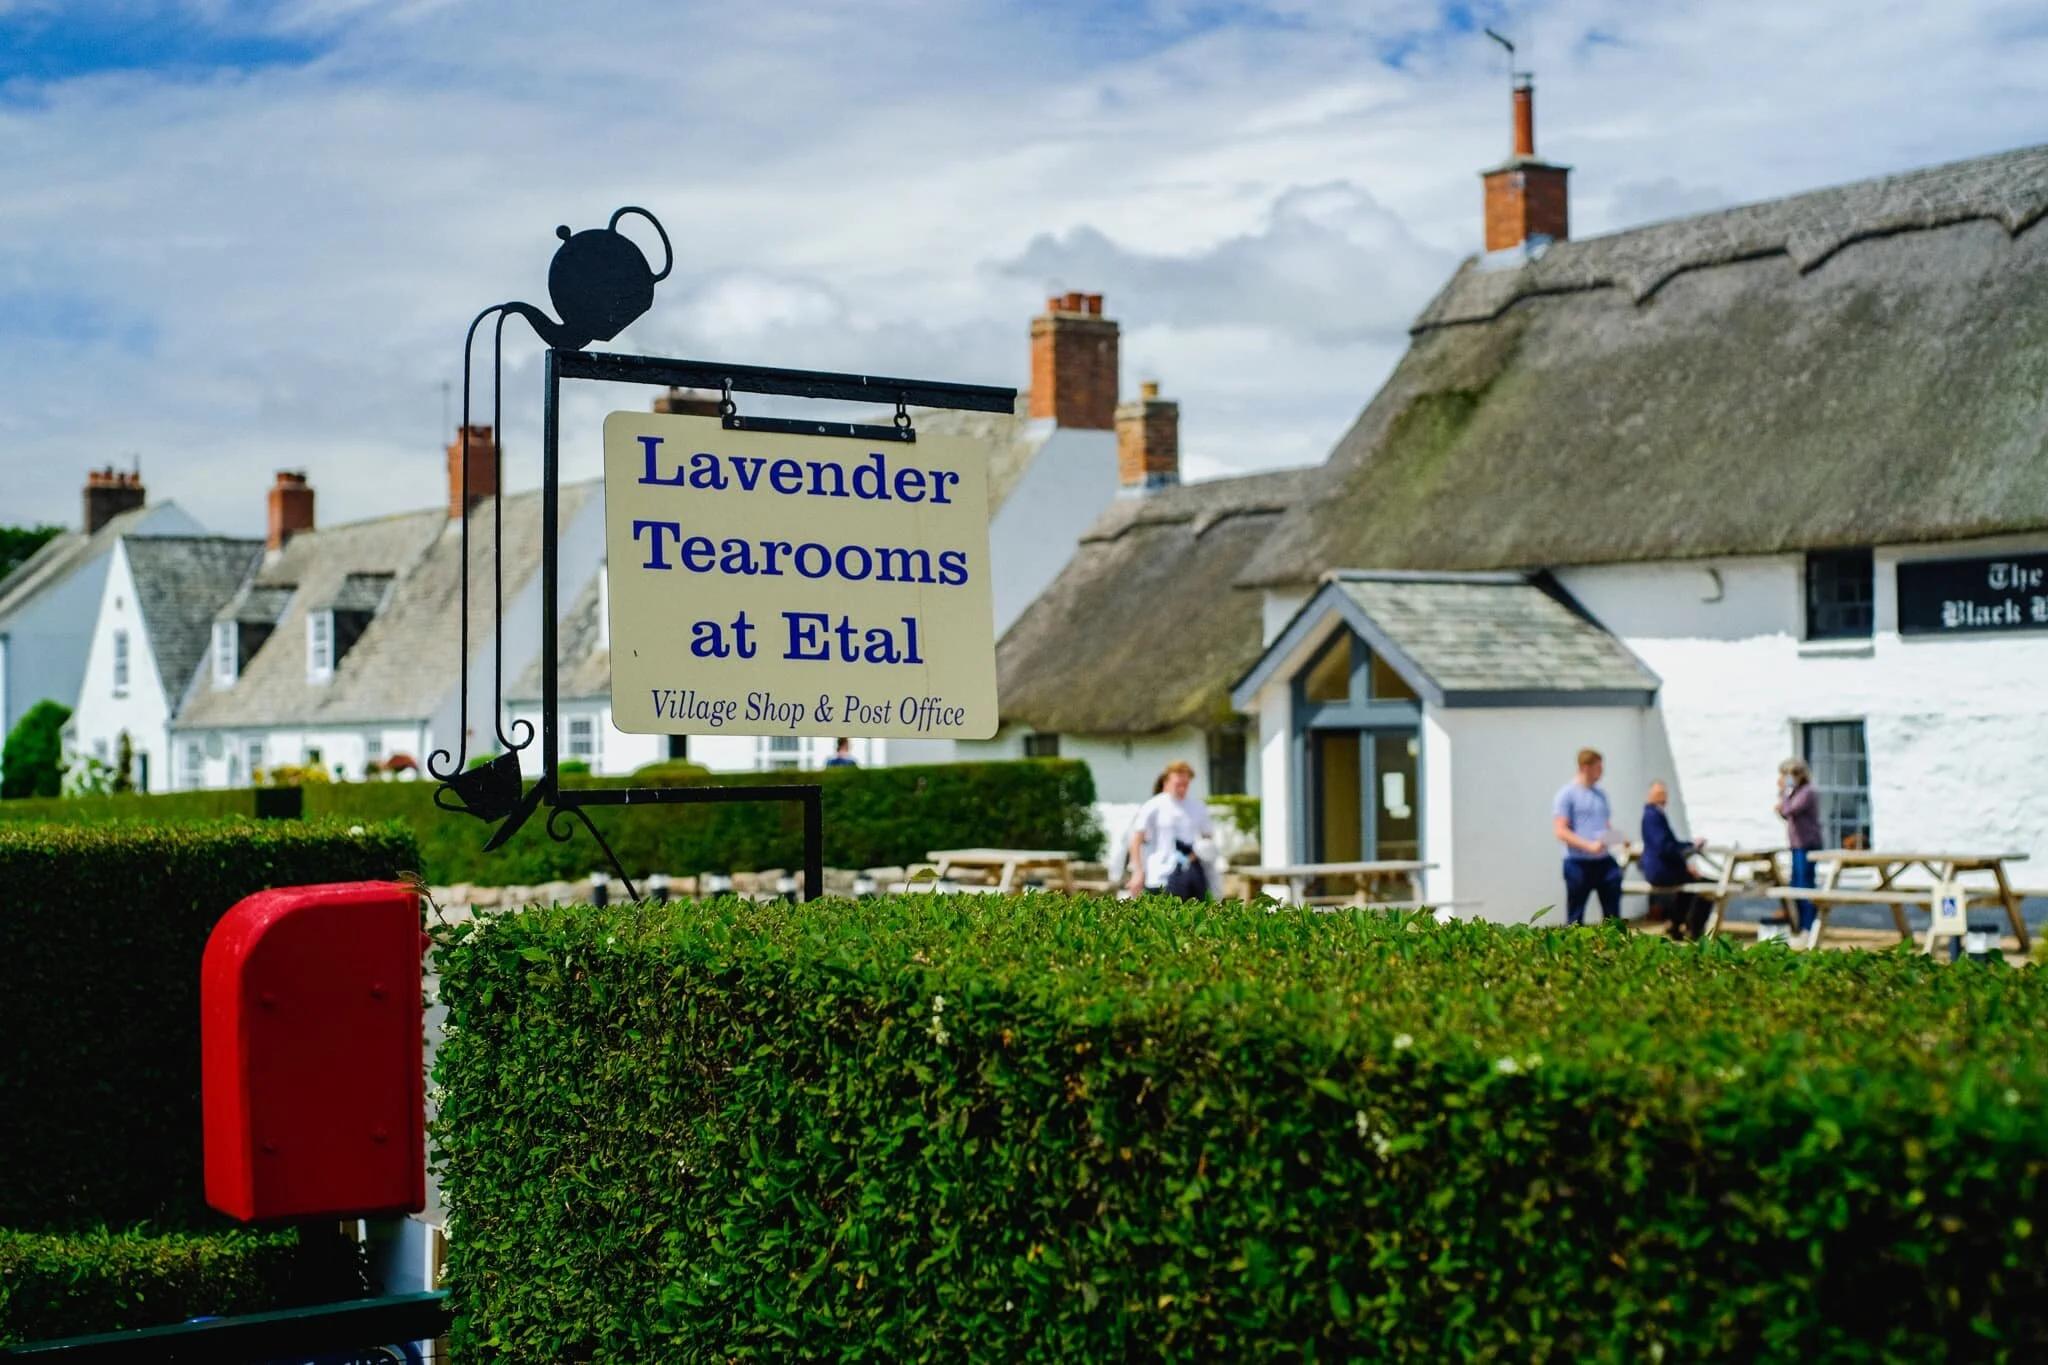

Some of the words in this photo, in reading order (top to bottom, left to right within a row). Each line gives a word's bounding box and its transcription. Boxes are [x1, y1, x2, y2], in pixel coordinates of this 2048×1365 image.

[637, 436, 960, 504] Lavender
[633, 520, 969, 586] Tearooms
[1988, 563, 2043, 592] The
[690, 610, 757, 659] at
[781, 611, 924, 664] Etal
[1943, 599, 2021, 627] Black
[651, 690, 737, 727] Village
[745, 692, 805, 728] Shop
[814, 694, 834, 723] &
[842, 695, 893, 725] Post
[899, 697, 965, 732] Office
